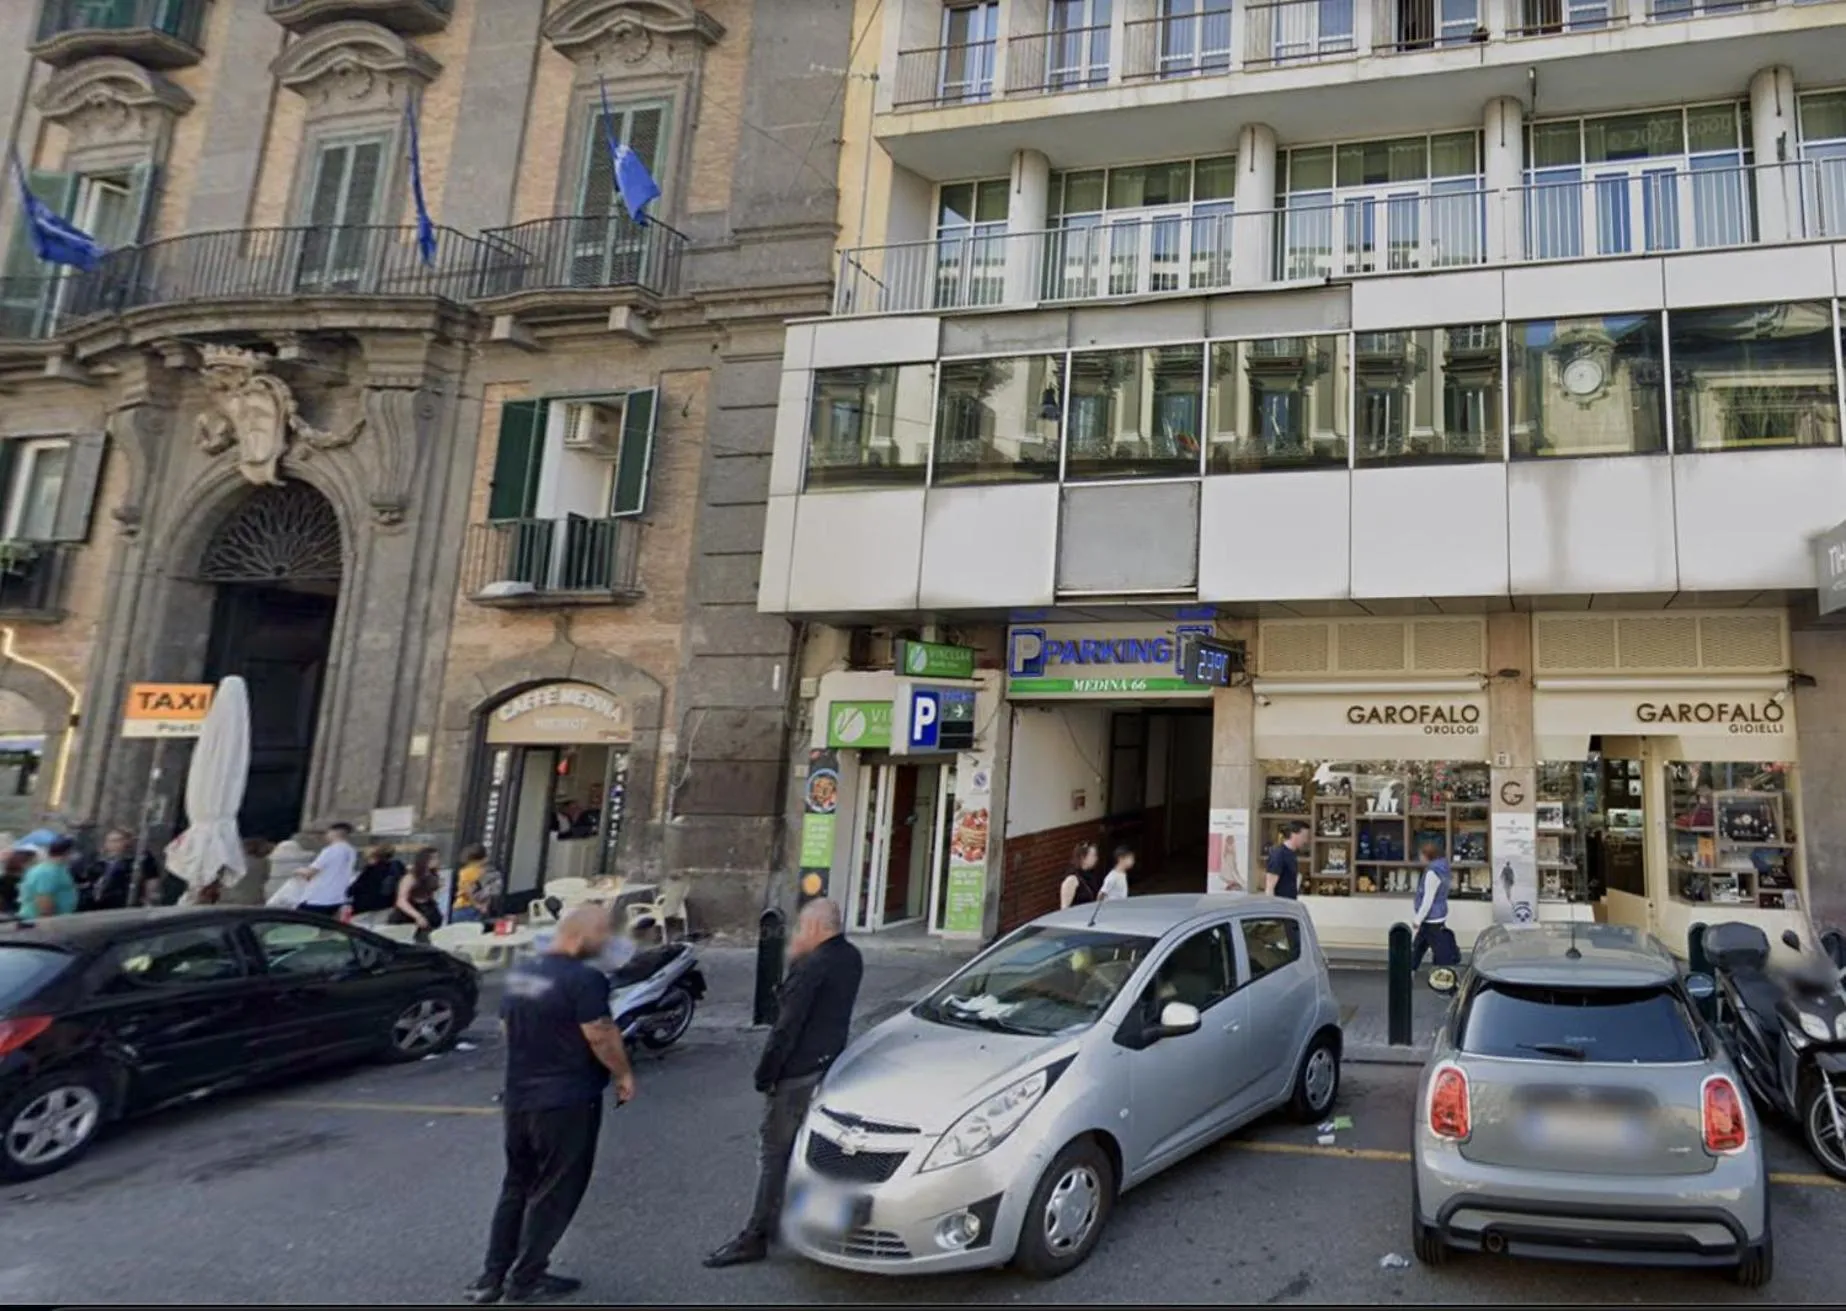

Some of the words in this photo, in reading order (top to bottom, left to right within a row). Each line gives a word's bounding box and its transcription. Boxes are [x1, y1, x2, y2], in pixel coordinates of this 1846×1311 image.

[1043, 638, 1172, 664] PARKING
[1072, 679, 1126, 691] MEDINA
[1131, 680, 1147, 690] 66
[136, 692, 207, 710] TAXI
[913, 696, 937, 741] P
[1347, 704, 1480, 724] GAROFALO
[1636, 702, 1784, 723] GAROFALO
[1423, 725, 1479, 735] OROLOGI
[1729, 724, 1784, 734] GIOIELLI
[1500, 781, 1525, 806] G
